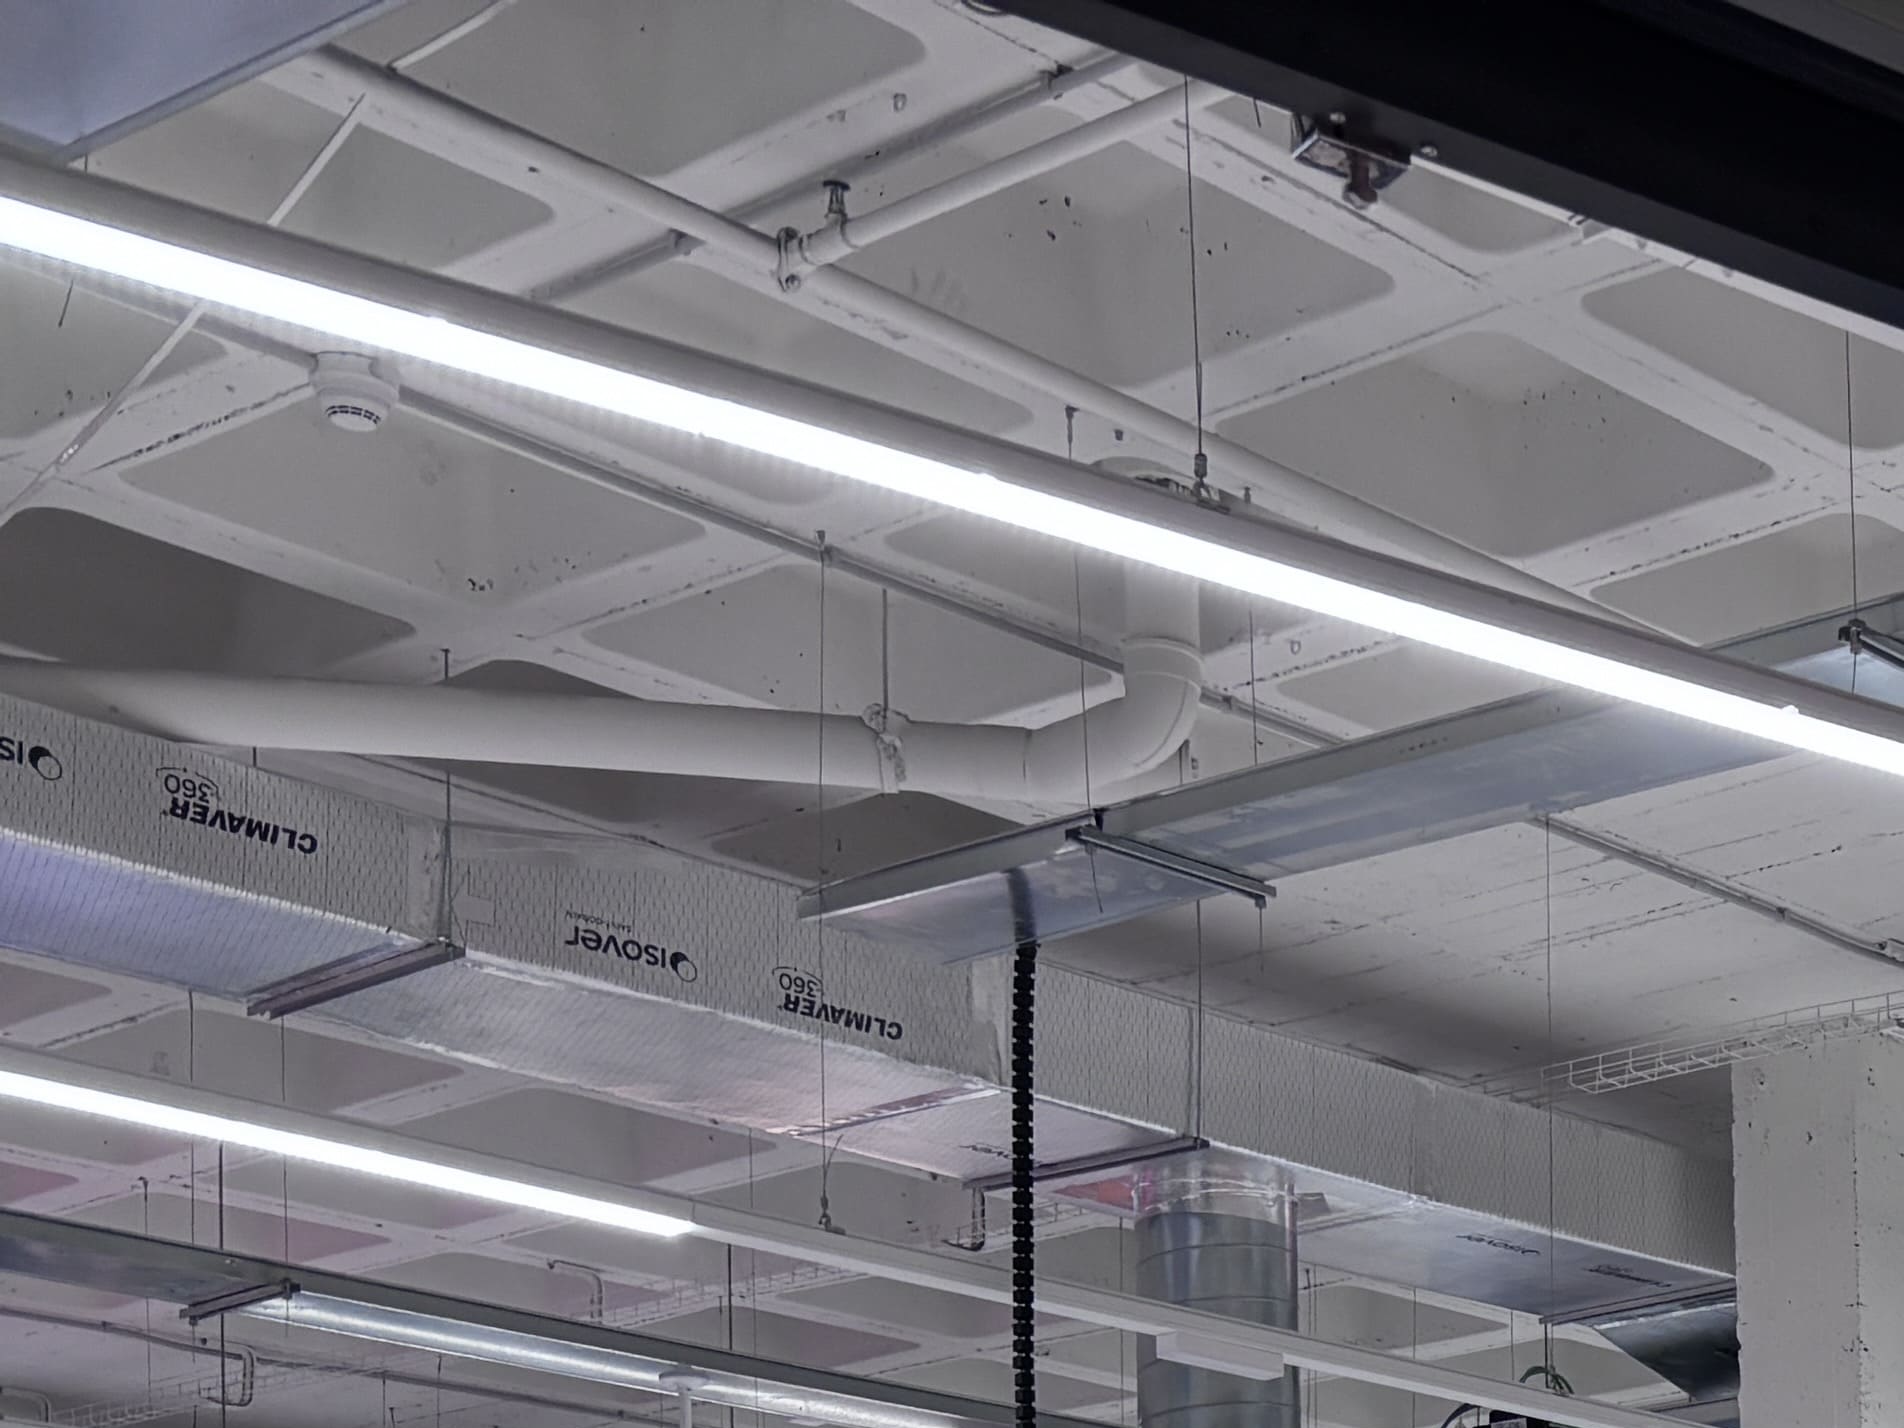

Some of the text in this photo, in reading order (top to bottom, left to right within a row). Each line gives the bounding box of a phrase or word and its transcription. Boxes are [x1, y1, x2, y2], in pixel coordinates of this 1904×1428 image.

[163, 773, 212, 803] 360
[168, 797, 318, 854] CLIMAVER
[783, 993, 903, 1040] CLIMAVER
